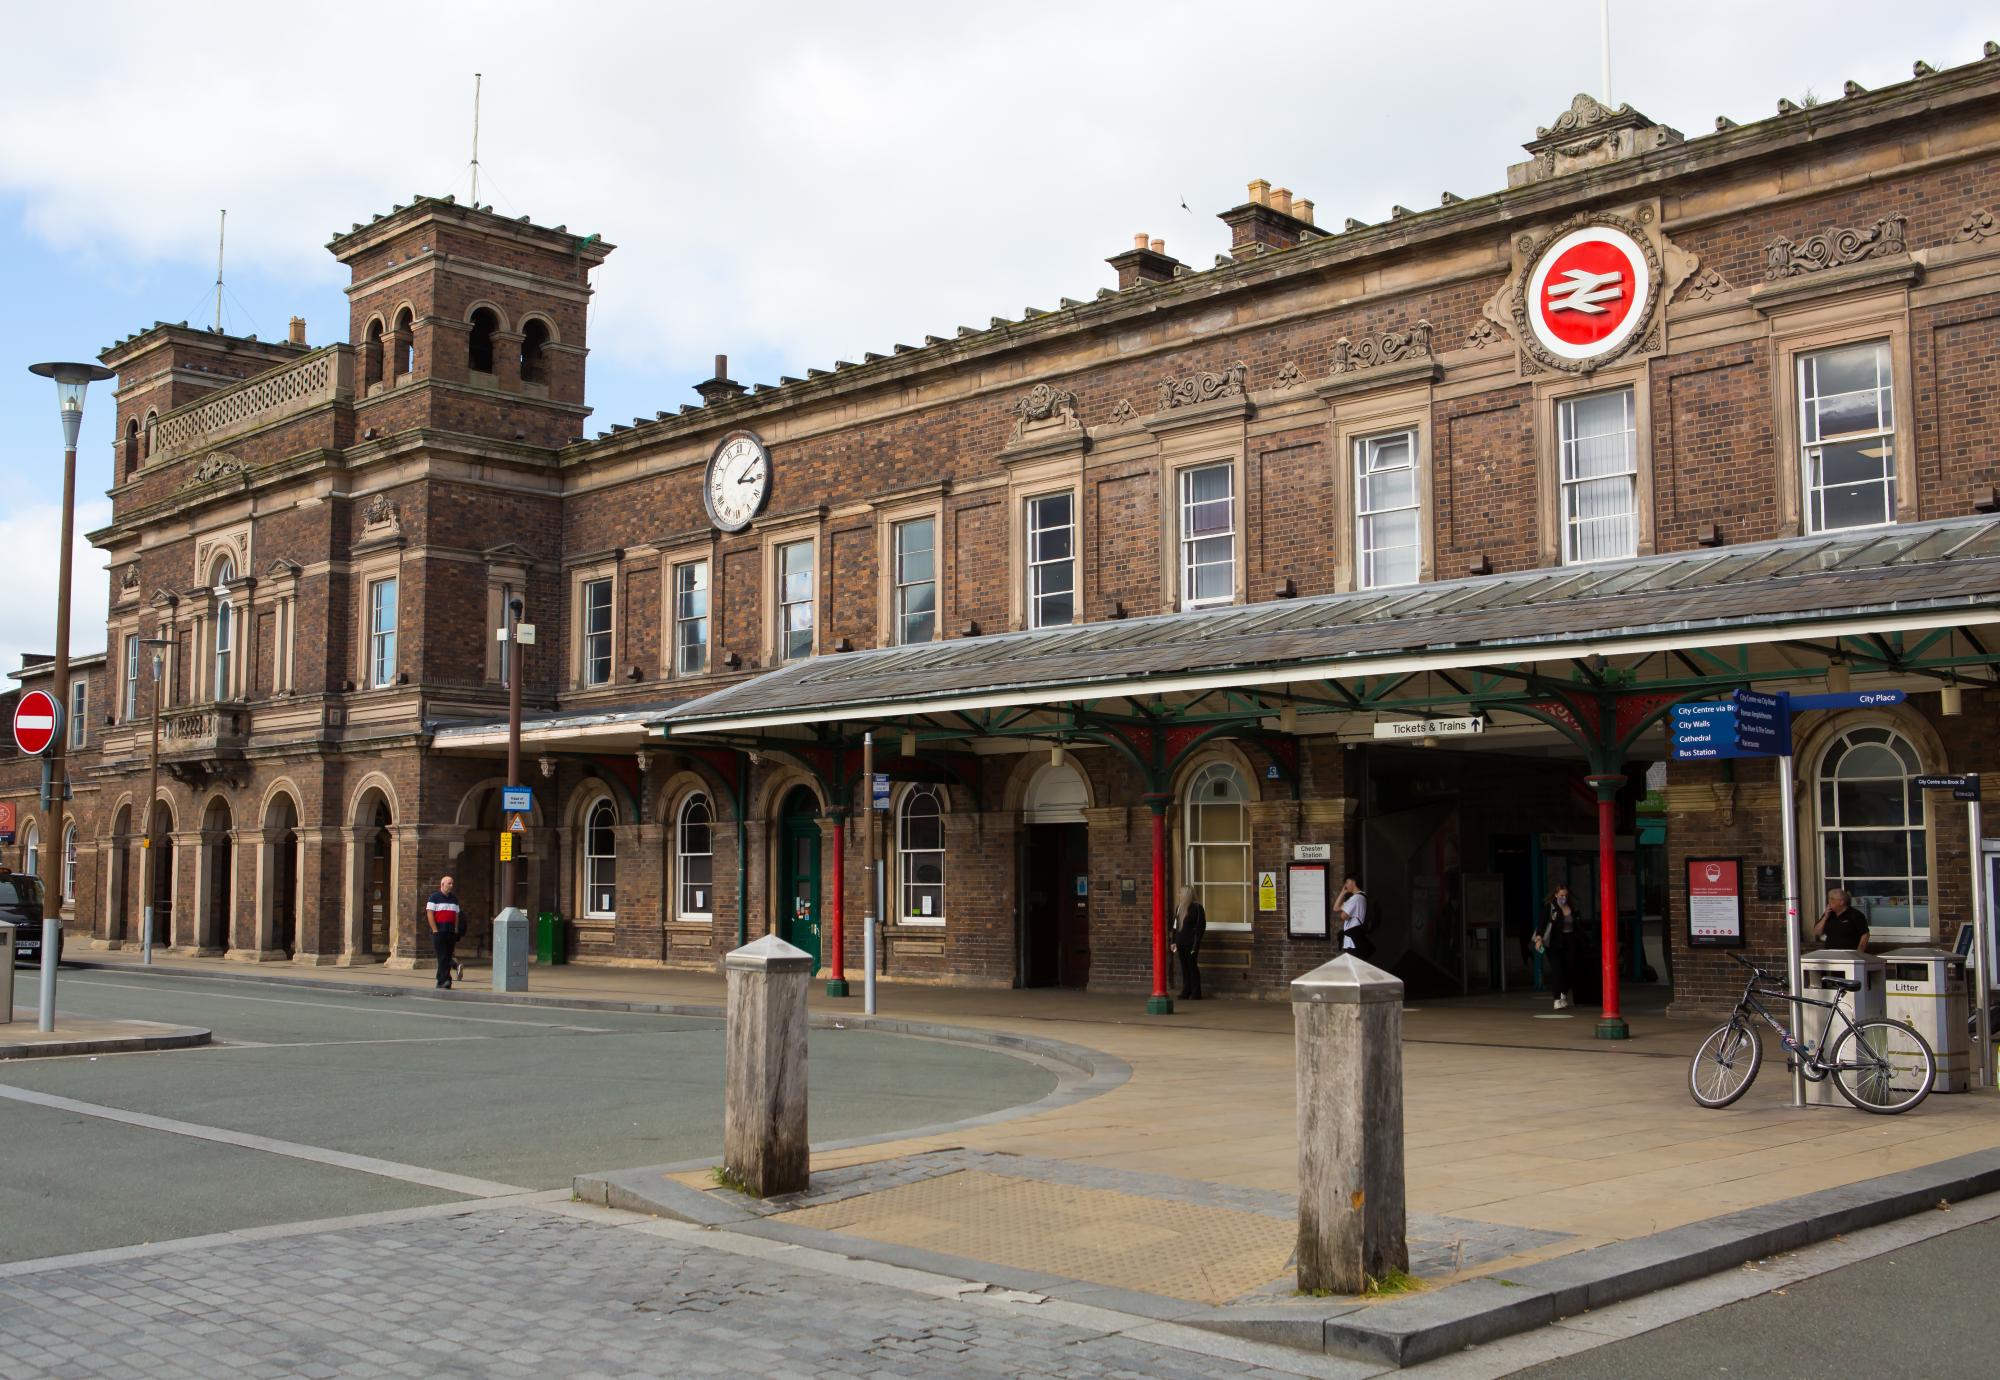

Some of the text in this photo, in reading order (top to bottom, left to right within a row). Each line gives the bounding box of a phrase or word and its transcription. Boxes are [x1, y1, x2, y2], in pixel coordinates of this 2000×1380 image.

[1393, 721, 1466, 734] Tickets & Trains
[1680, 734, 1710, 742] Cathedral
[1895, 984, 1919, 992] Litter
